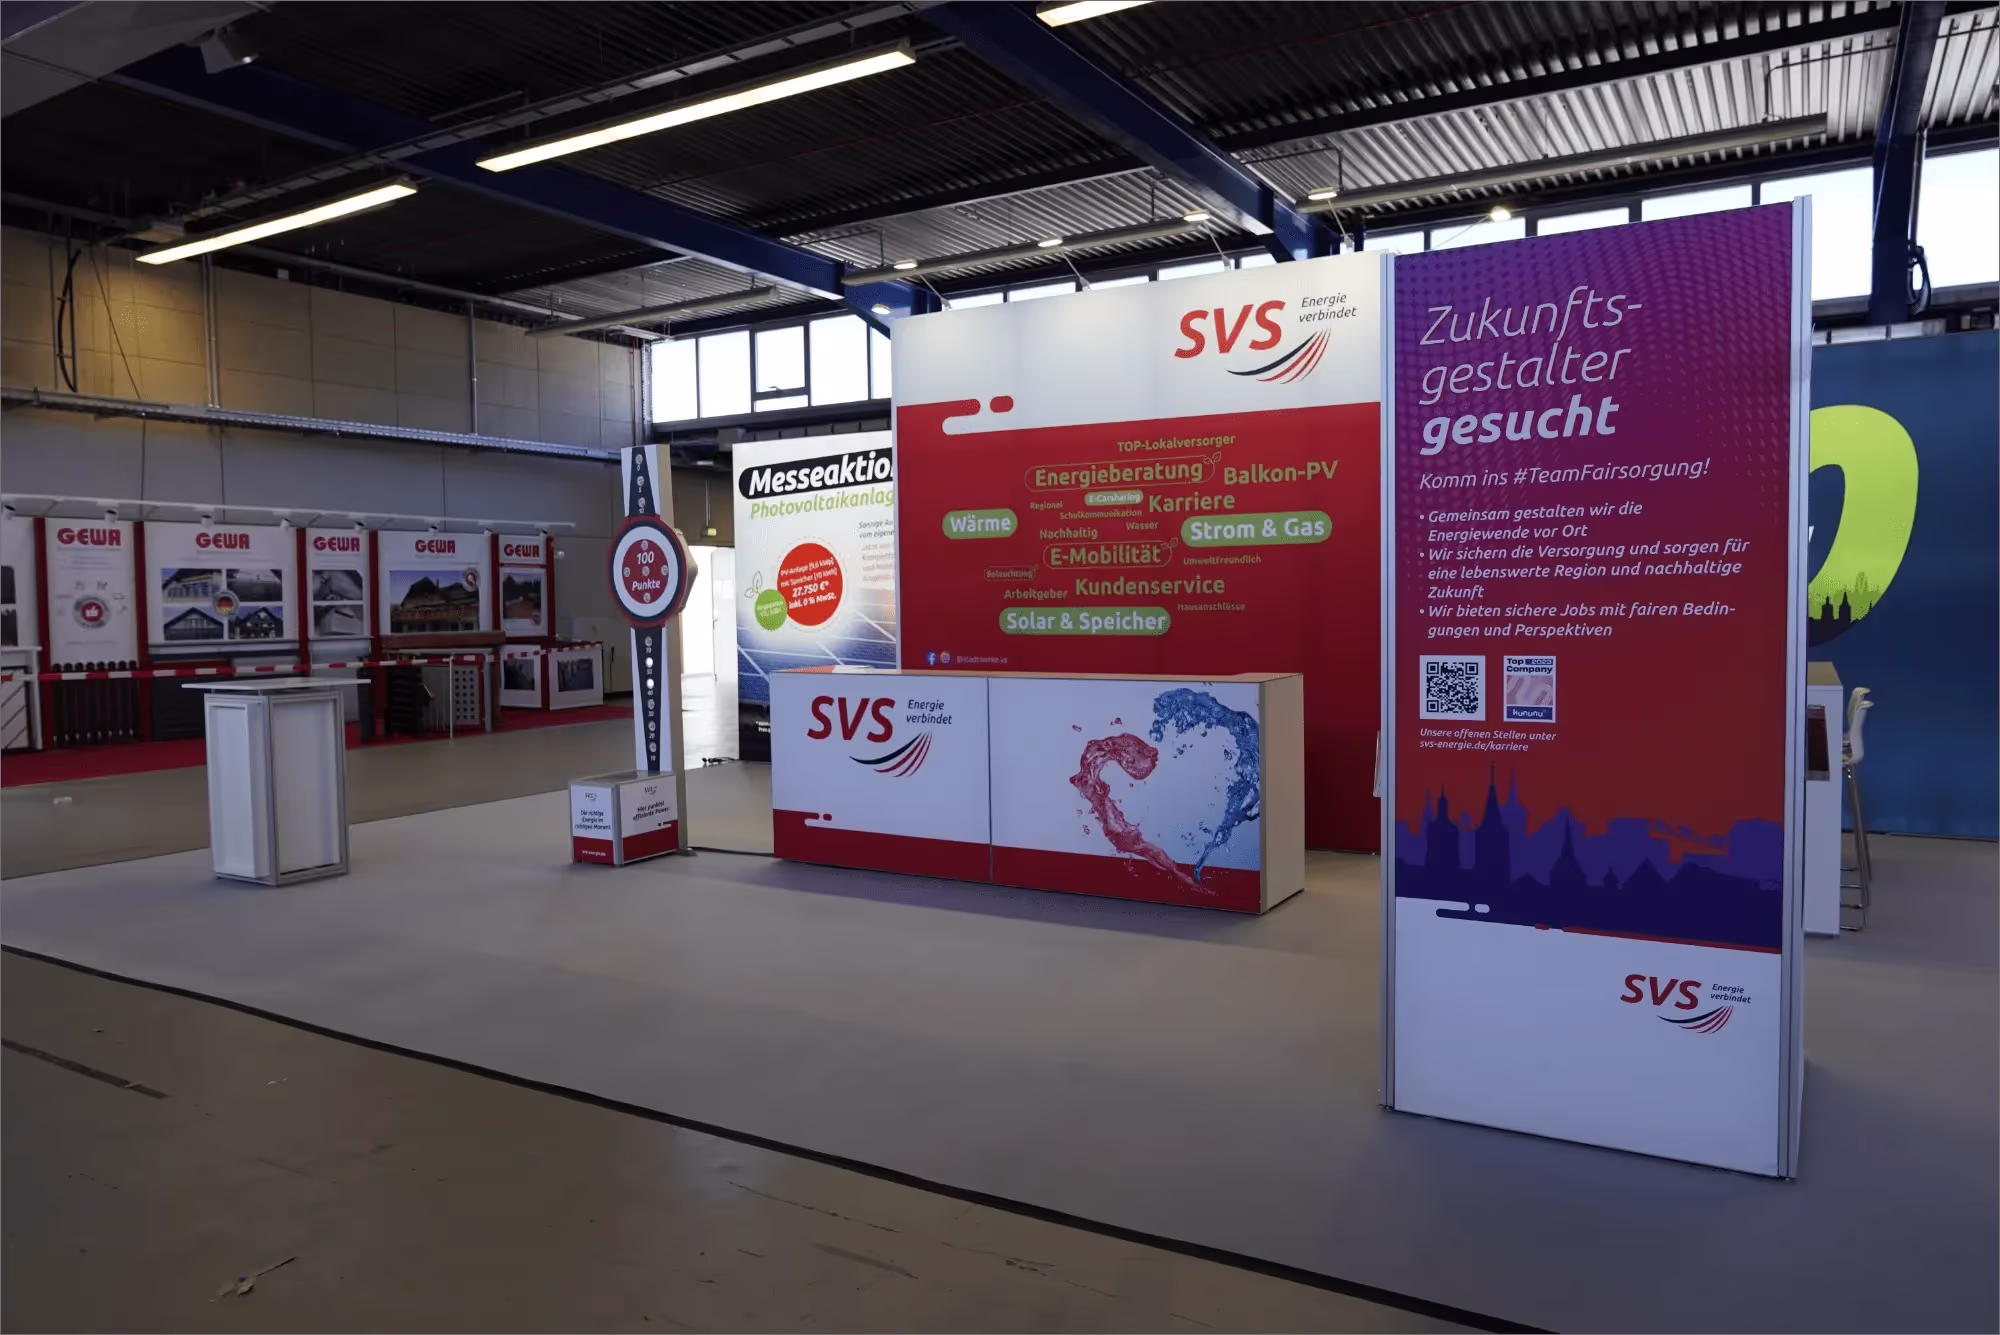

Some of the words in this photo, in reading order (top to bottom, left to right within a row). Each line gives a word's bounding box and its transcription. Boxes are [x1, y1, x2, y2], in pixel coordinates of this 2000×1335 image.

[1301, 292, 1347, 308] Energie
[1299, 306, 1358, 322] verbindet
[1419, 285, 1642, 345] Zukunfts-
[1174, 299, 1286, 358] SVS
[1419, 341, 1631, 405] gestalter
[1419, 393, 1619, 455] gesucht
[1117, 434, 1236, 452] TOP-Lokalversorger
[749, 450, 893, 496] Messeaktio
[1035, 463, 1203, 489] Energieberatung
[1224, 459, 1339, 485] Balkon-PV
[1419, 472, 1477, 490] Komm
[1482, 470, 1508, 486] ins
[1513, 457, 1711, 484] #TeamFairsorgung!
[1087, 491, 1140, 504] E-Carsharing
[1149, 491, 1235, 512] Karriere
[1029, 501, 1063, 511] Regional
[1428, 509, 1509, 522] Gemeinsam
[1513, 504, 1585, 522] gestalten
[1589, 502, 1615, 516] wir
[1619, 501, 1643, 515] die
[1060, 509, 1142, 520] Schulkommunikation
[950, 514, 1012, 533] Wärme
[1126, 521, 1158, 530] Wasser
[1190, 521, 1255, 540] Strom
[1261, 519, 1277, 538] &
[1284, 518, 1324, 537] Gas
[57, 527, 121, 546] GEWA
[196, 532, 250, 550] GEWA
[1040, 528, 1098, 539] Nachhaltig
[1428, 526, 1530, 543] Energiewende
[1533, 526, 1558, 538] vor
[1562, 525, 1588, 538] Ort
[313, 536, 360, 552] GEWA
[415, 539, 456, 554] GEWA
[504, 543, 540, 558] GEWA
[1428, 547, 1453, 560] Wir
[1456, 546, 1507, 560] sichern
[1511, 545, 1534, 558] die
[1538, 544, 1625, 559] Versorgung
[1629, 541, 1660, 555] und
[1663, 542, 1719, 556] sorgen
[1722, 538, 1750, 555] für
[636, 551, 655, 565] 100
[1050, 545, 1161, 565] E-Mobilität
[1183, 555, 1261, 566] Umweltfreundlich
[1428, 567, 1457, 580] eine
[1460, 565, 1550, 579] lebenswerte
[1554, 563, 1606, 580] Region
[1611, 561, 1642, 576] und
[1645, 559, 1742, 576] nachhaltige
[632, 578, 661, 591] Punkte
[792, 582, 819, 598] 27.750
[1075, 575, 1225, 596] Kundenservice
[1428, 585, 1484, 600] Zukunft
[1004, 588, 1067, 600] Arbeitgeber
[1177, 602, 1245, 611] Hausanschlüsse
[1428, 604, 1453, 617] Wir
[1456, 604, 1501, 617] bieten
[1505, 603, 1557, 617] sichere
[1560, 603, 1596, 617] Jobs
[1599, 602, 1626, 616] mit
[1628, 601, 1677, 618] fairen
[1682, 601, 1736, 616] Bedin-
[1006, 611, 1055, 630] Solar
[1060, 612, 1073, 630] &
[1079, 610, 1166, 634] Speicher
[1427, 624, 1480, 638] gungen
[1484, 623, 1511, 636] und
[1514, 622, 1612, 638] Perspektiven
[1506, 665, 1553, 674] Company
[1507, 658, 1524, 666] Top
[908, 699, 945, 712] Energie
[1512, 708, 1543, 717] kununu
[807, 695, 896, 743] SVS
[905, 712, 952, 725] verbindet
[1420, 727, 1452, 737] Unsere
[1454, 728, 1490, 739] offenen
[1493, 730, 1526, 739] Stellen
[1529, 732, 1556, 741] unter
[1419, 740, 1529, 752] svs-energie.de/karriere
[1620, 973, 1702, 1010] SVS
[1711, 983, 1745, 994] Energie
[1710, 992, 1752, 1003] verbindet
